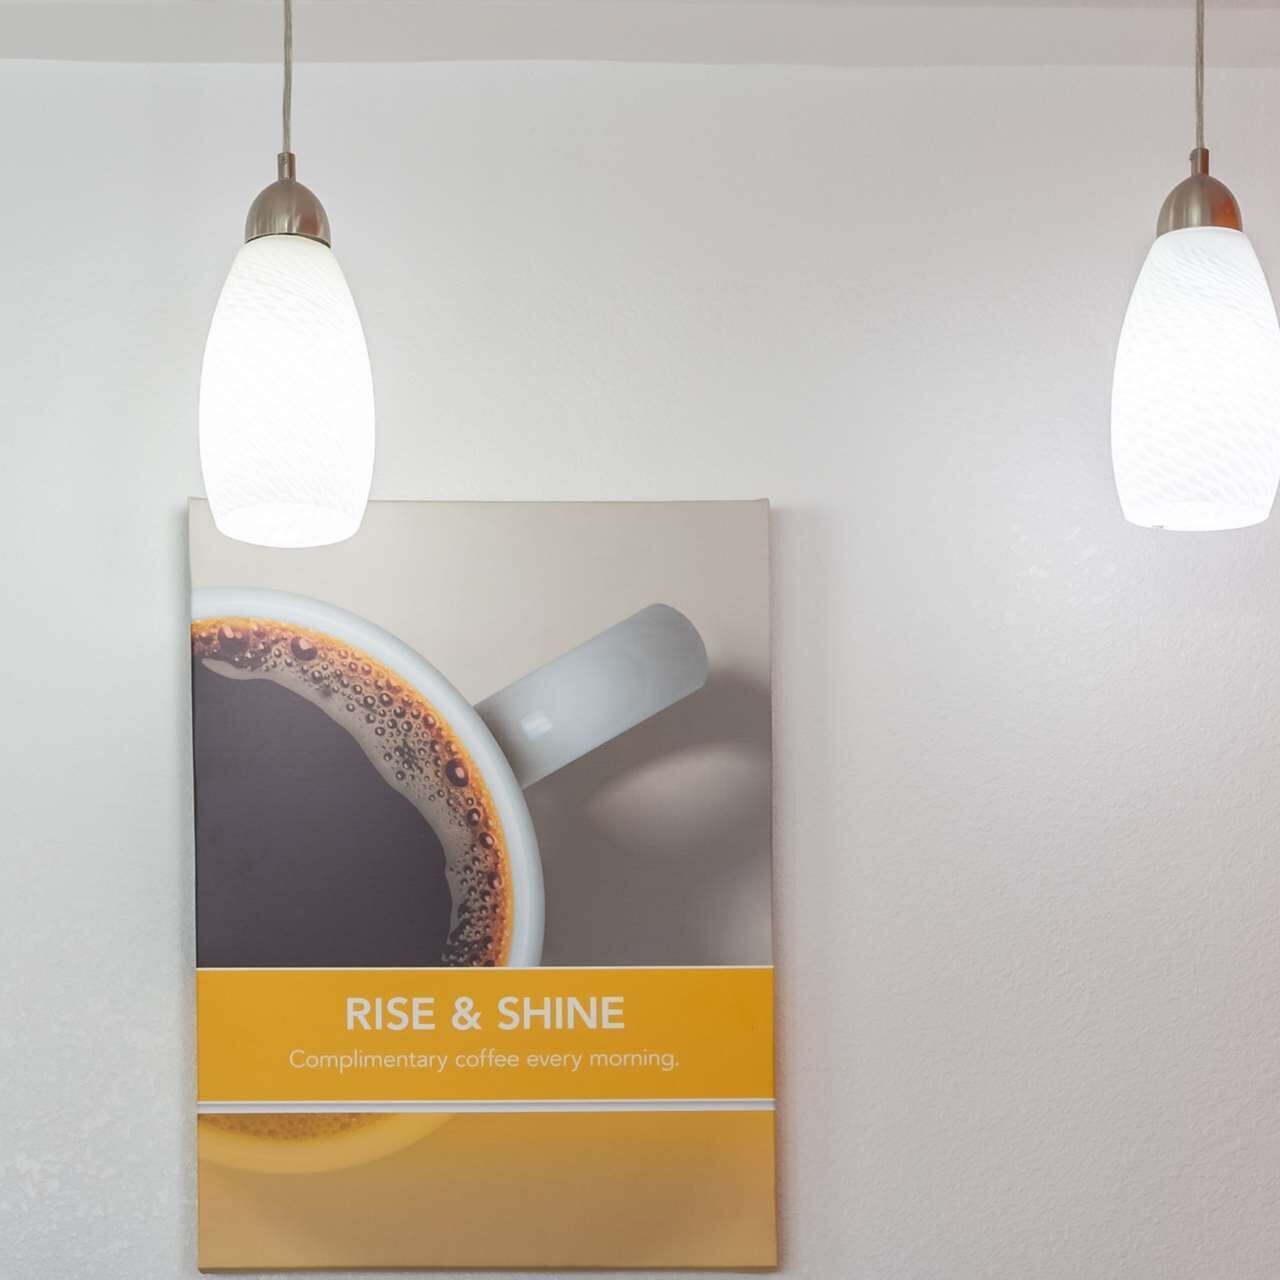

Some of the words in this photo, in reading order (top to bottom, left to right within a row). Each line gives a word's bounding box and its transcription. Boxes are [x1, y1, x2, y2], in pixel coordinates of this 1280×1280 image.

[346, 996, 436, 1032] RISE
[451, 996, 482, 1031] &
[497, 996, 625, 1031] SHINE
[289, 1049, 448, 1074] Complimentary
[455, 1048, 519, 1068] coffee
[527, 1053, 583, 1073] every
[589, 1049, 680, 1071] morning.
